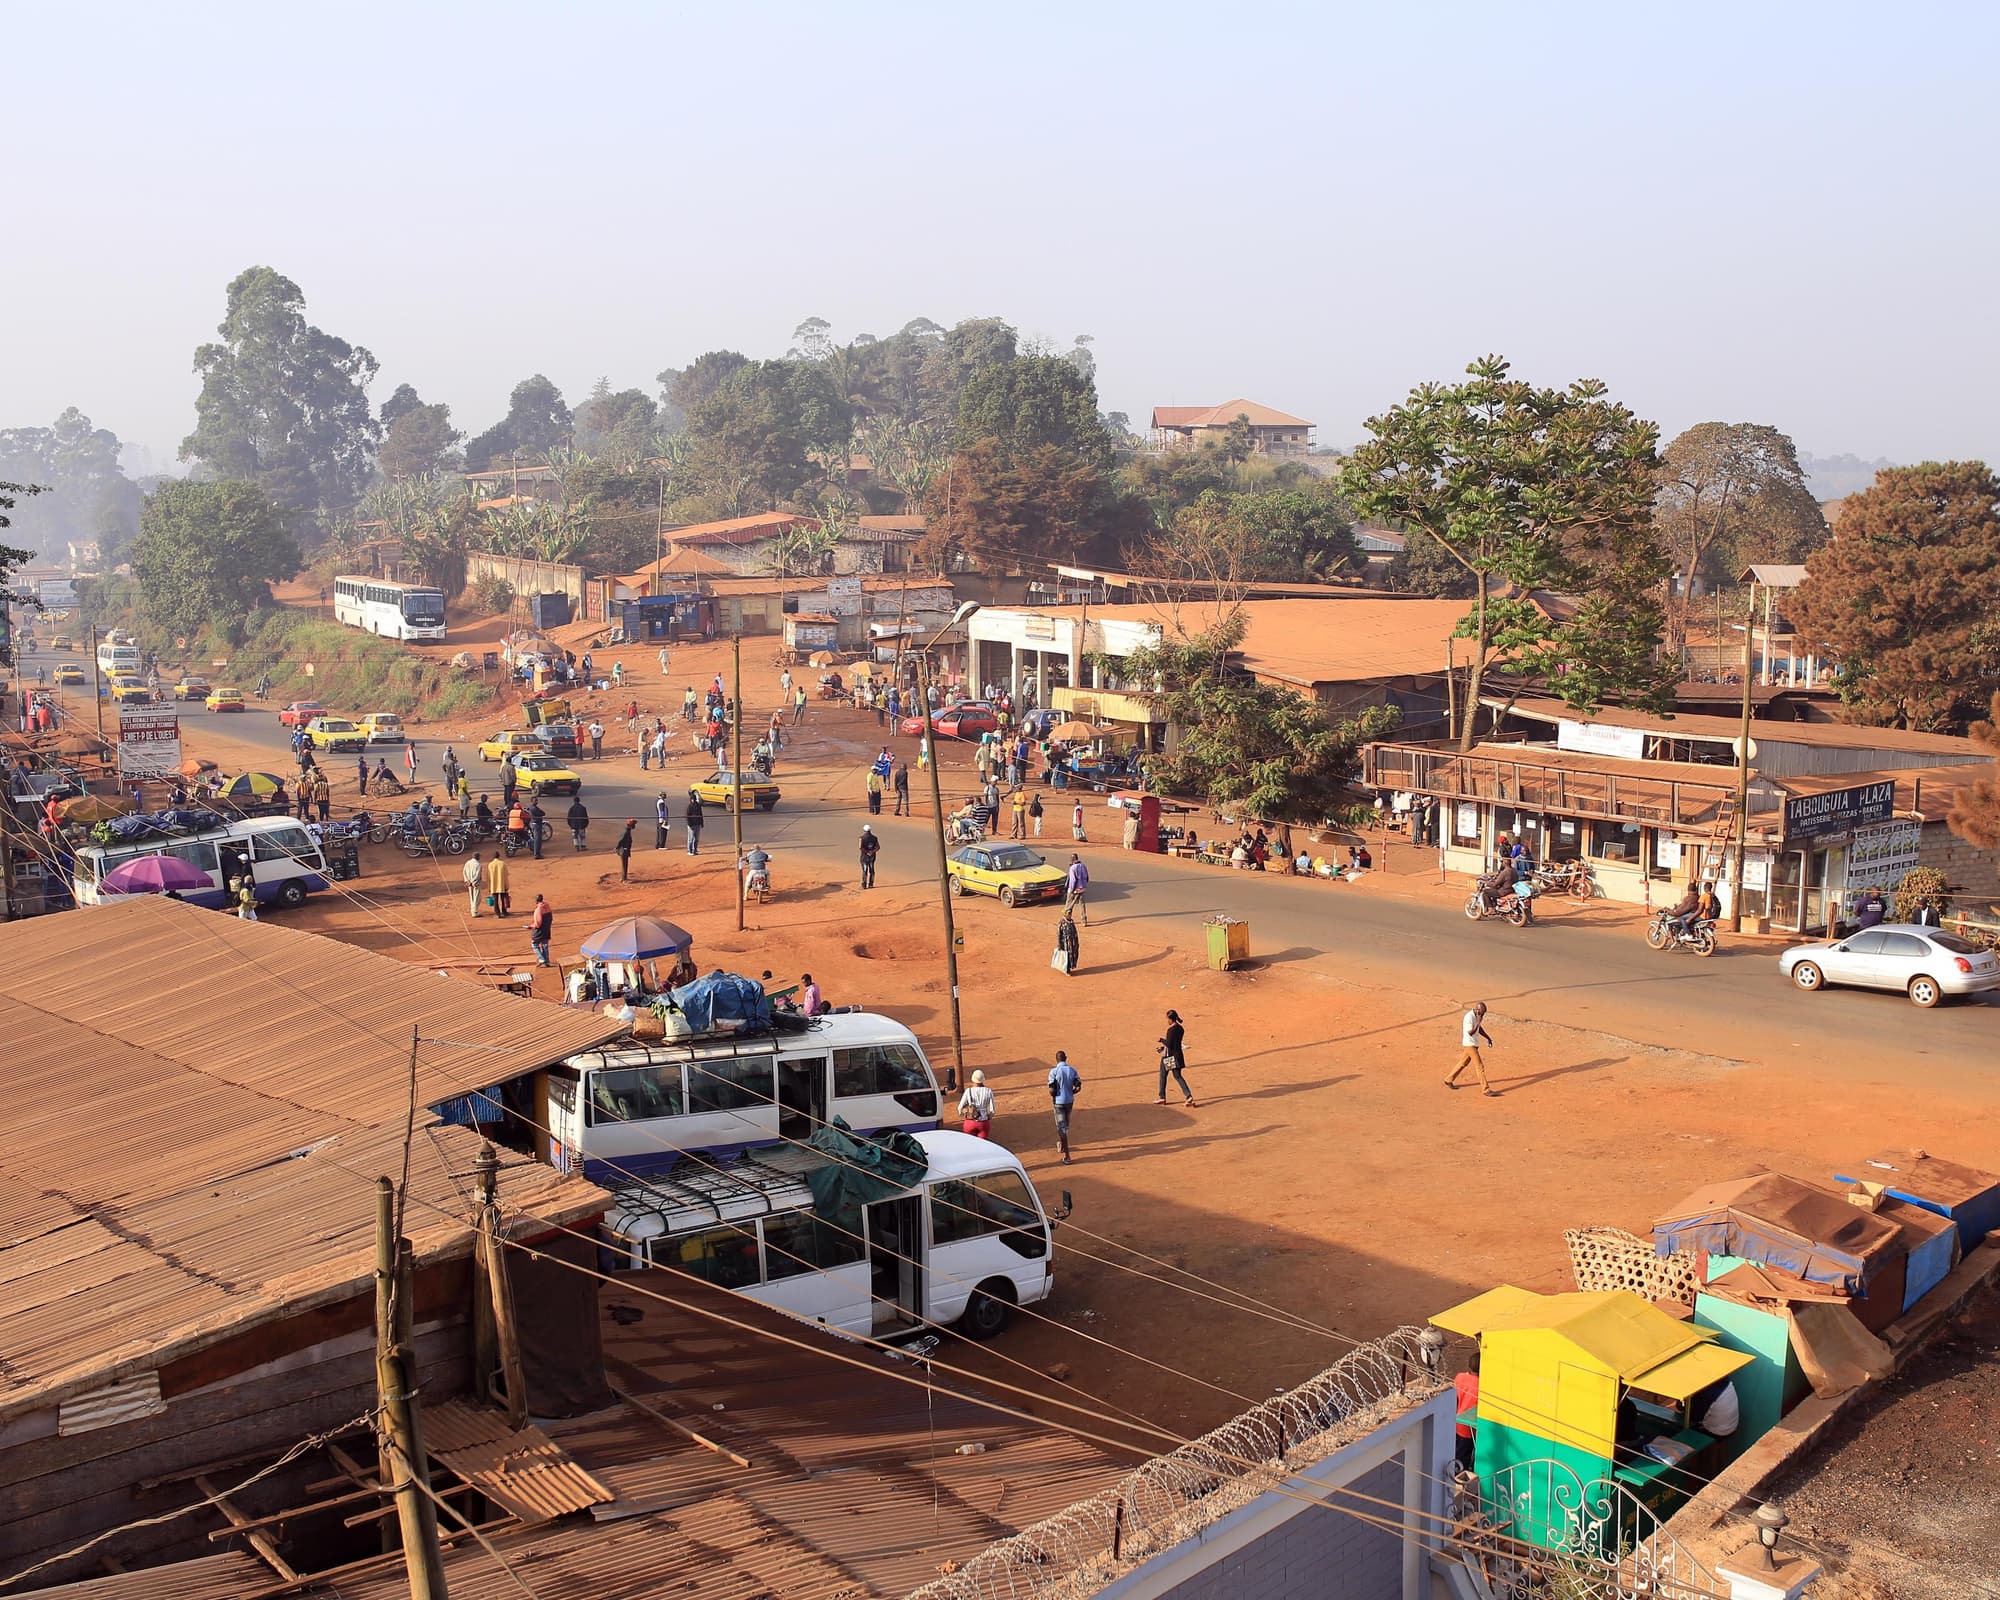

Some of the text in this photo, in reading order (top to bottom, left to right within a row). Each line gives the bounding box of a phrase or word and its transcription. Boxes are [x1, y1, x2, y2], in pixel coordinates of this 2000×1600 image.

[146, 730, 153, 740] DE
[154, 729, 175, 740] L'OUEST
[1790, 791, 1849, 819] TABOUGUIA
[1859, 783, 1891, 806] PLAZA
[1800, 814, 1832, 828] PATISSERIE
[1837, 809, 1858, 820] PIZZAS
